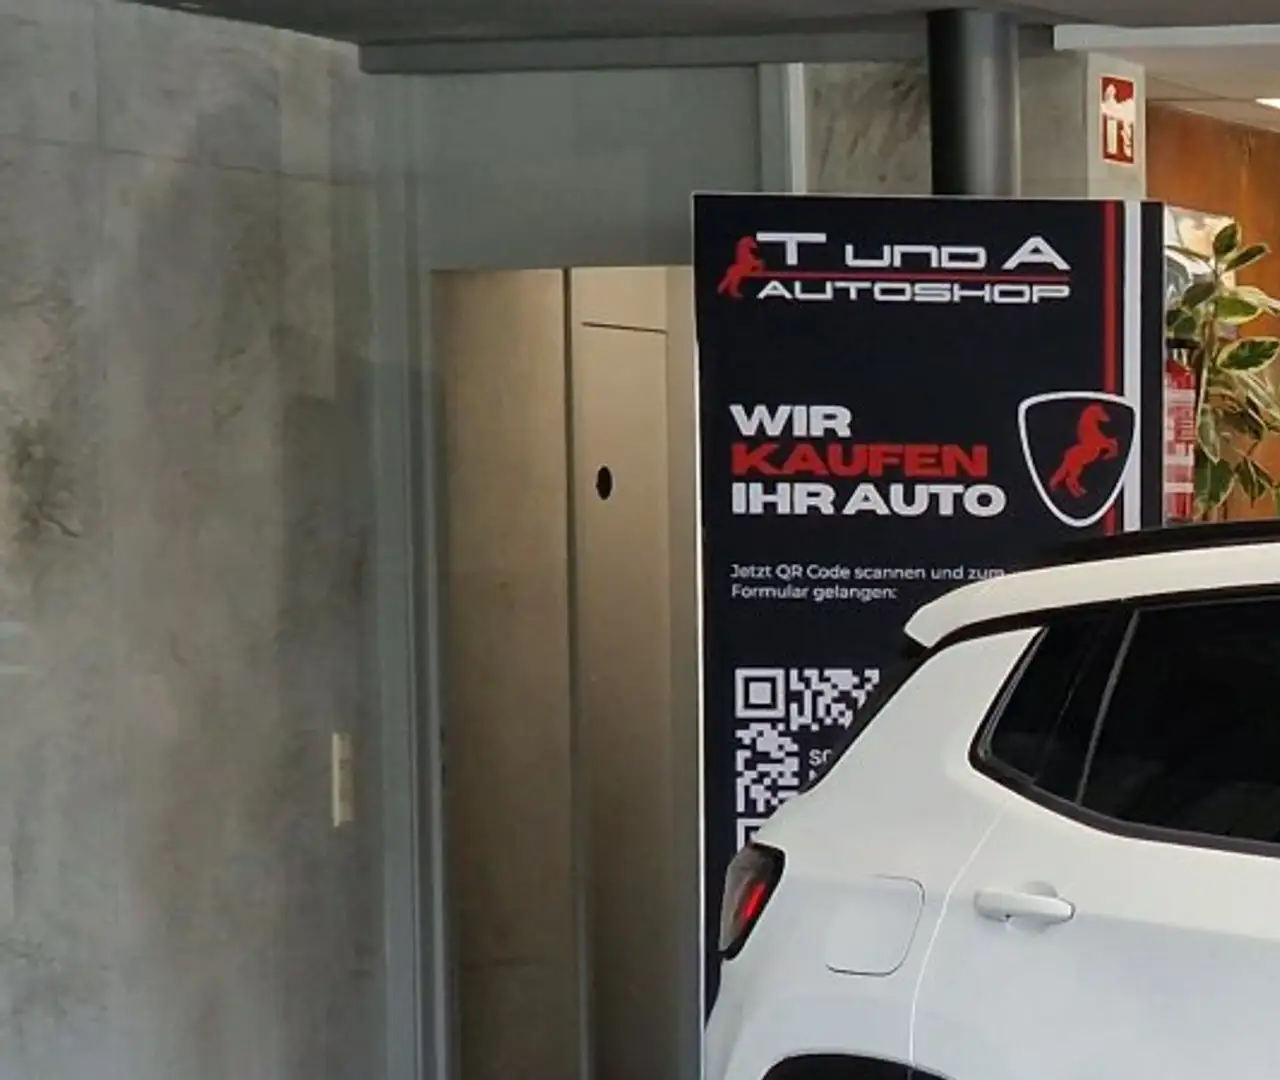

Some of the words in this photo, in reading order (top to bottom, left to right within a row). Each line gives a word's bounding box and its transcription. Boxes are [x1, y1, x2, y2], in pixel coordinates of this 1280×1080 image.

[755, 232, 827, 266] T
[1002, 235, 1071, 270] A
[756, 279, 1071, 304] AUTOSHOP
[729, 403, 853, 438] WIR
[731, 443, 989, 477] KAUFEN
[731, 482, 837, 516] IHR
[842, 483, 1007, 517] AUTO
[730, 563, 772, 579] Jetzt
[775, 563, 803, 581] QR
[806, 563, 850, 579] Code
[854, 567, 926, 580] scannen
[931, 565, 964, 580] und
[731, 583, 810, 599] Formular
[812, 584, 897, 602] gelangen:
